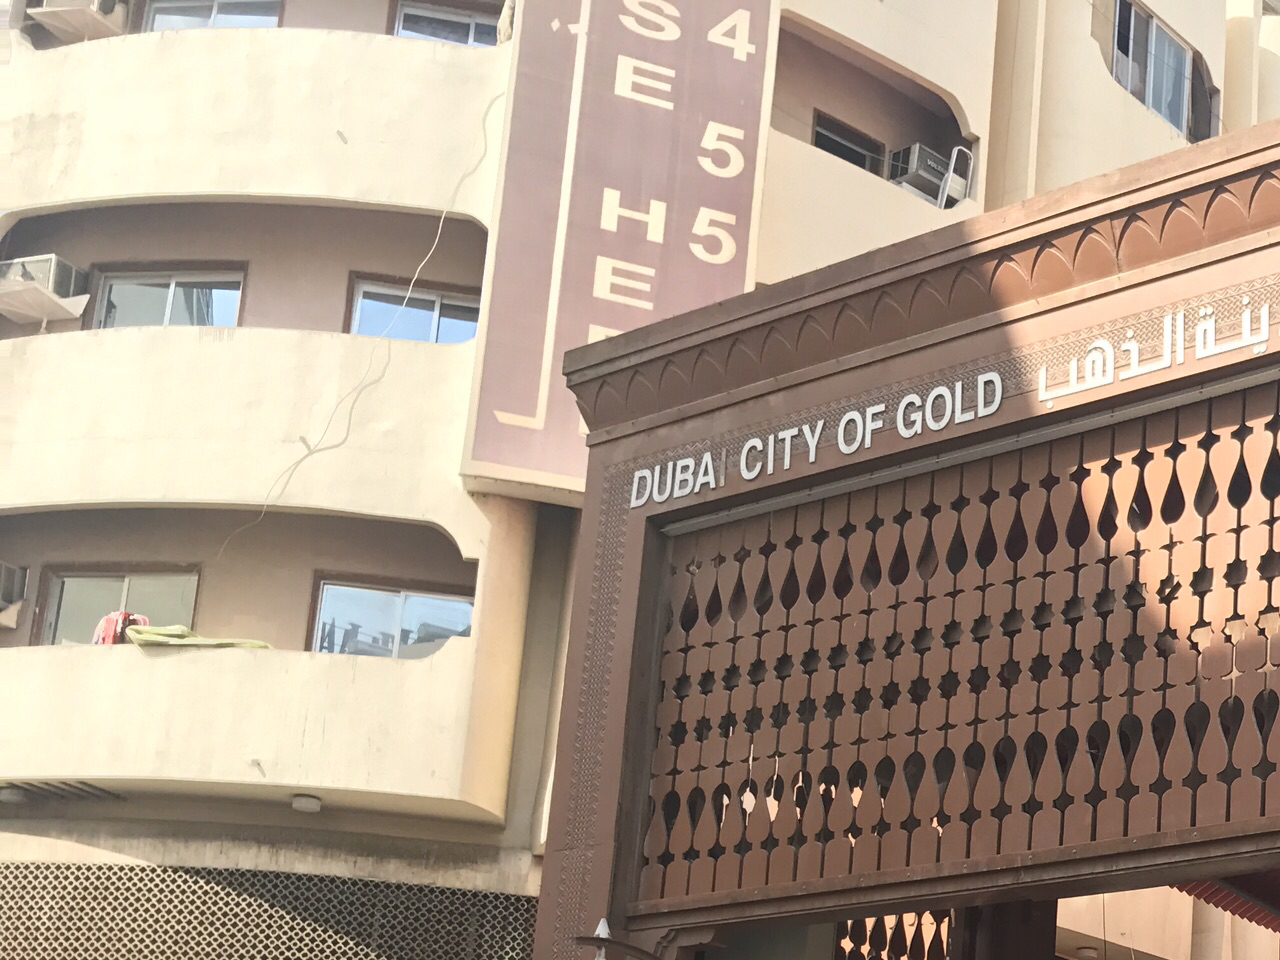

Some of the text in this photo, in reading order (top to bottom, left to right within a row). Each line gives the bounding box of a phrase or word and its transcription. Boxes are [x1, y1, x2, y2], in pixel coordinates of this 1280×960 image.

[1038, 309, 1185, 409] الذهب
[630, 371, 1003, 510] DUBAI CITY OF GOLD
